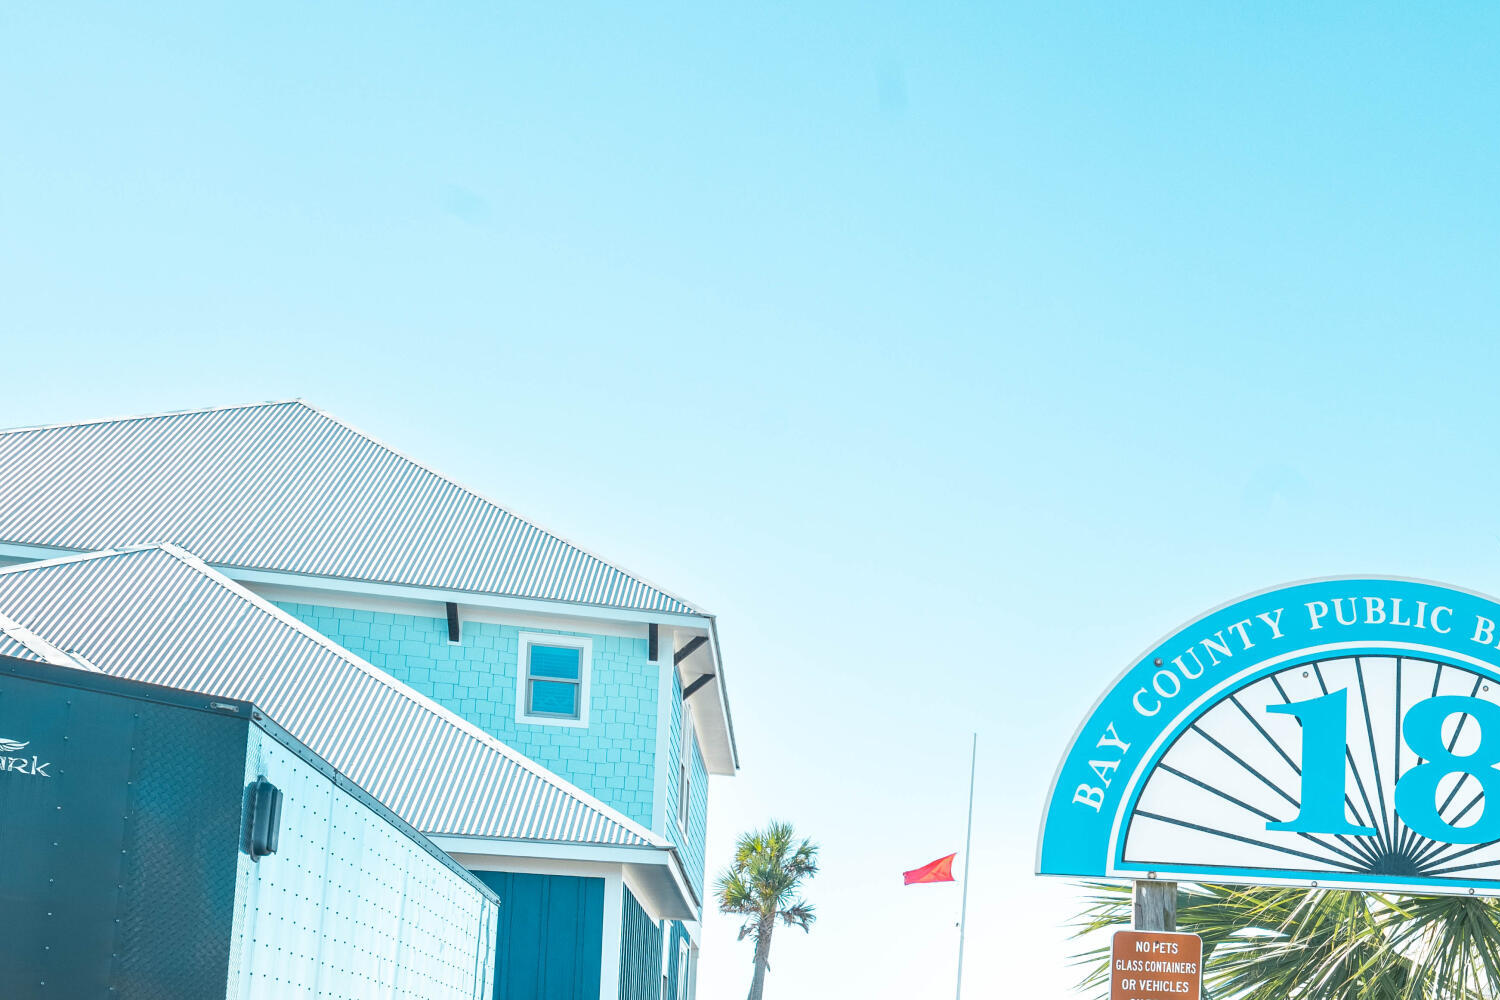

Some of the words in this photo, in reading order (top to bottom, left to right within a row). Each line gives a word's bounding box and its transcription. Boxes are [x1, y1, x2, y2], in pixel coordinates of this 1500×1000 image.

[1071, 719, 1132, 813] BAY
[1131, 607, 1285, 717] COUNTY
[1307, 595, 1455, 635] PUBLIC
[1136, 941, 1150, 952] NO
[1152, 942, 1178, 954] PETS
[1116, 959, 1143, 972] GLASS
[1145, 960, 1196, 974] CONTAINERS
[1122, 978, 1136, 990] OR
[1139, 980, 1189, 993] VEHICLES
